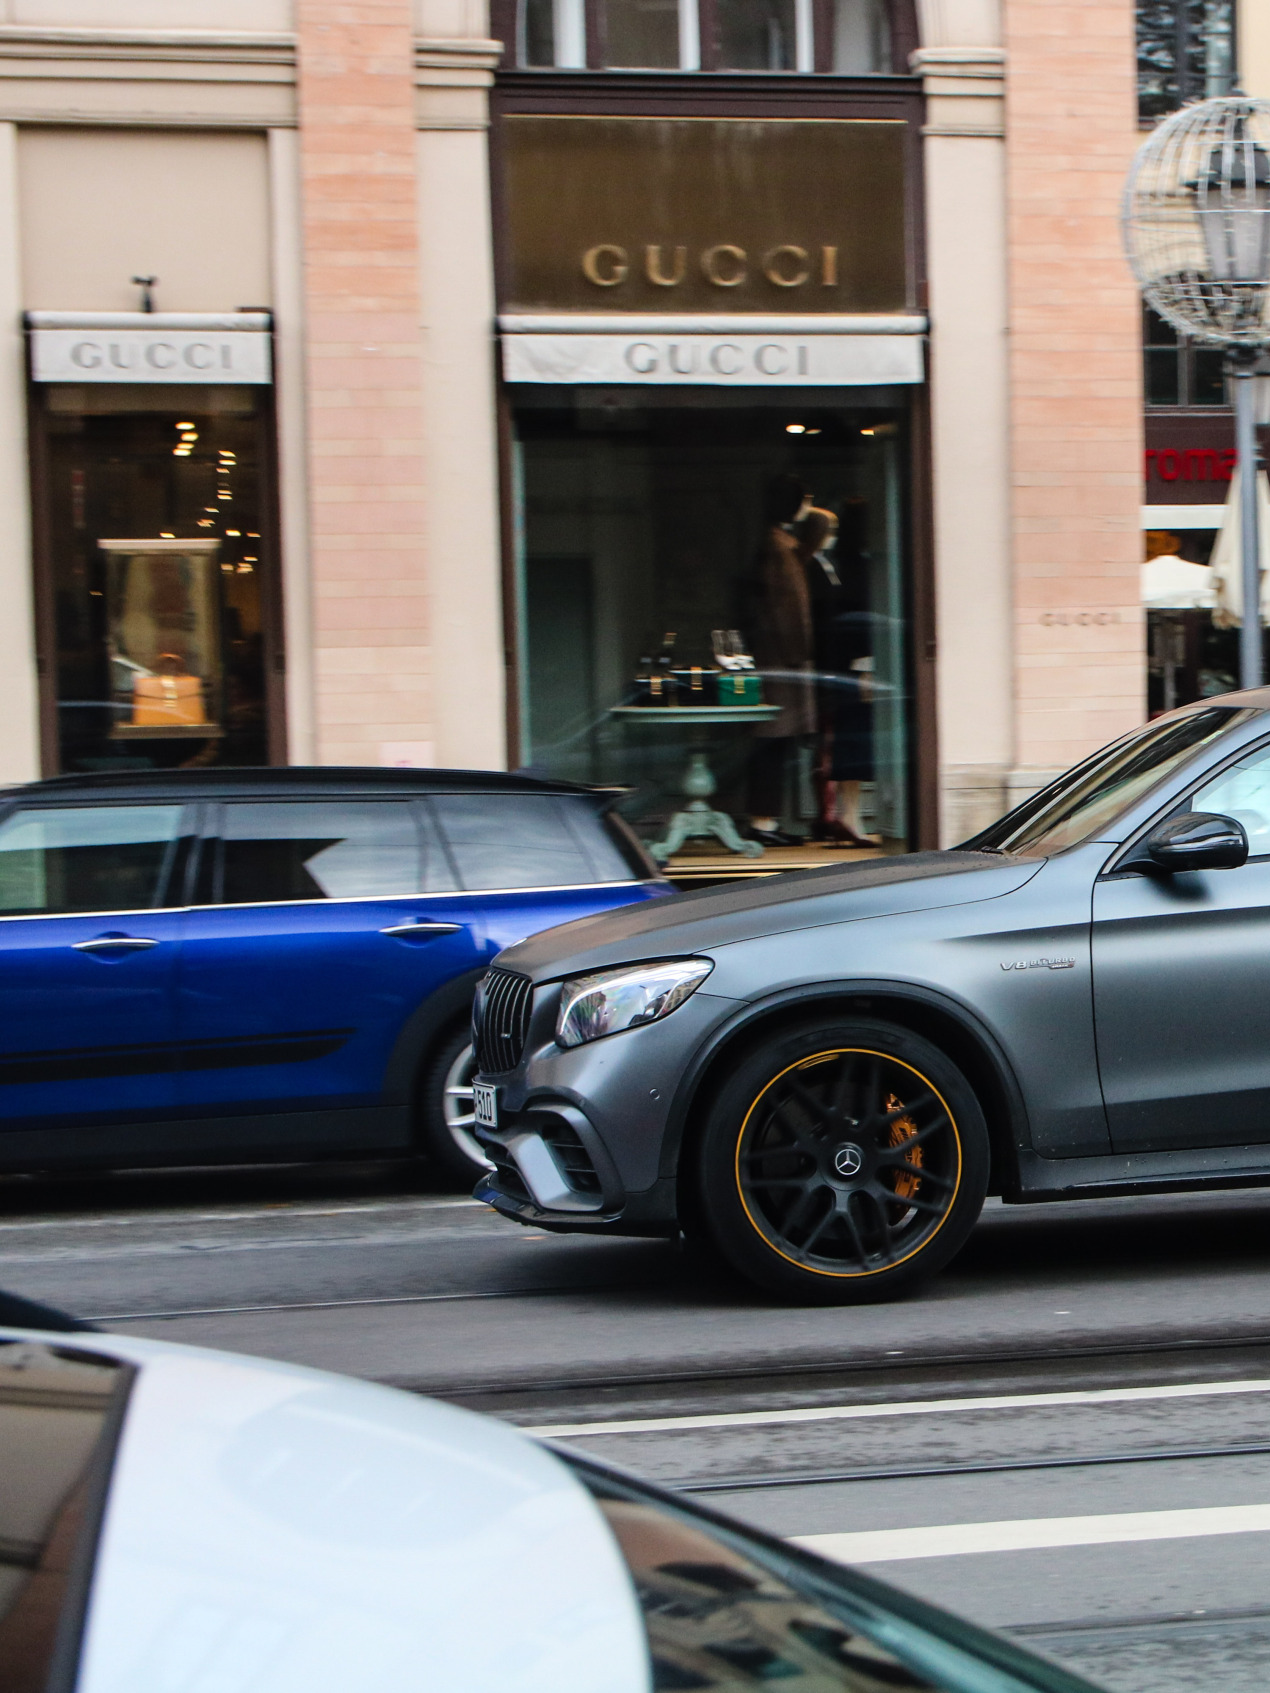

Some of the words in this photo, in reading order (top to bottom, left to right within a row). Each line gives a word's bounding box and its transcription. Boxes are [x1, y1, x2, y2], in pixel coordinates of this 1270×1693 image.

[583, 244, 838, 286] GUCCI
[70, 342, 233, 370] GUCCI
[623, 342, 809, 375] GUCCI
[1039, 612, 1121, 626] GUCCI
[1000, 960, 1027, 971] V8
